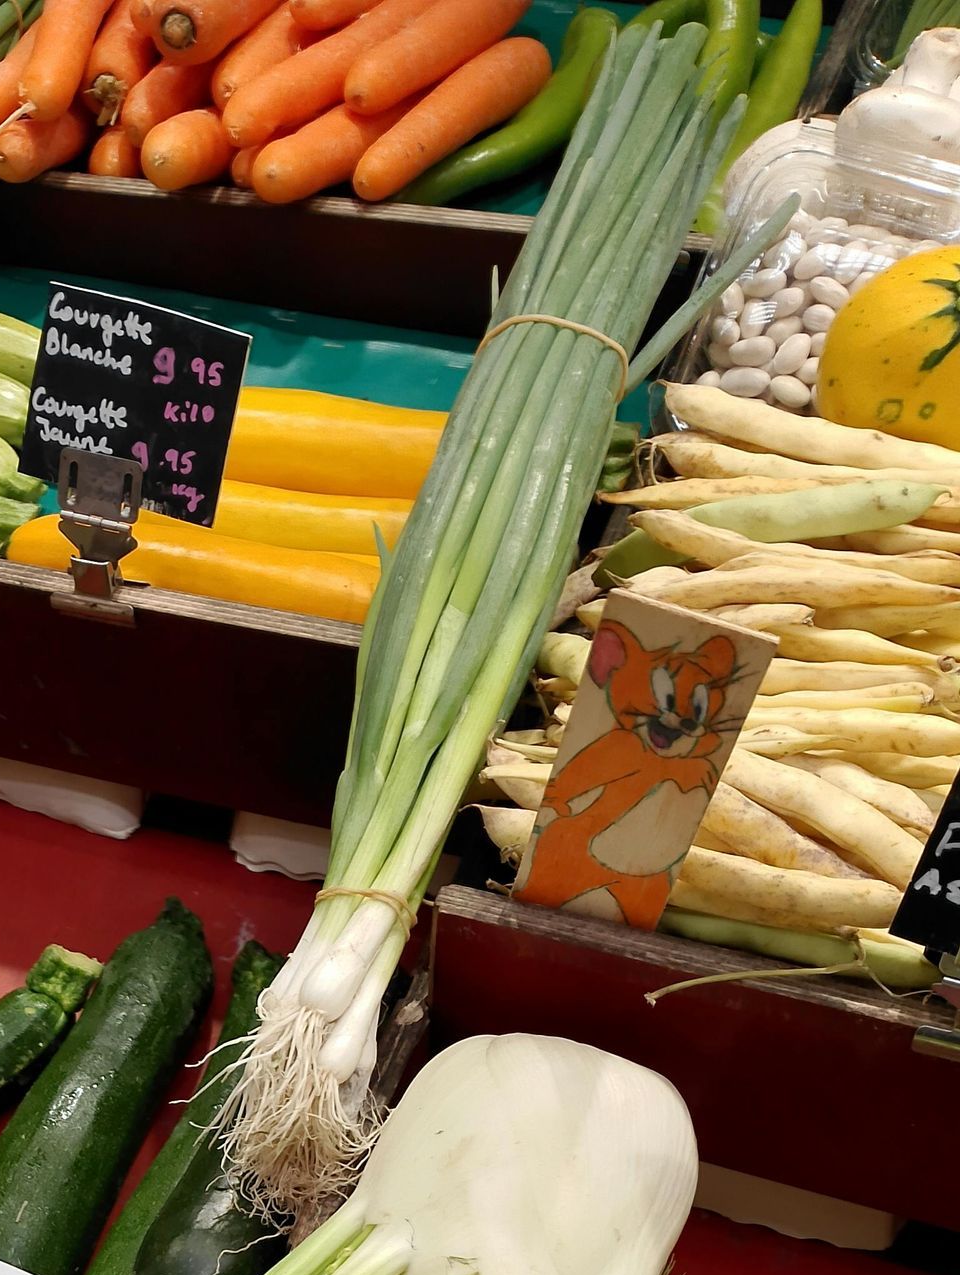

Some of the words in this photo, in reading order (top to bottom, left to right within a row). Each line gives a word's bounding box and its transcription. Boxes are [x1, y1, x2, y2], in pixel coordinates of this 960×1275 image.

[48, 291, 153, 346] Courgette
[45, 326, 133, 375] Blanche
[31, 386, 128, 432] Courgette
